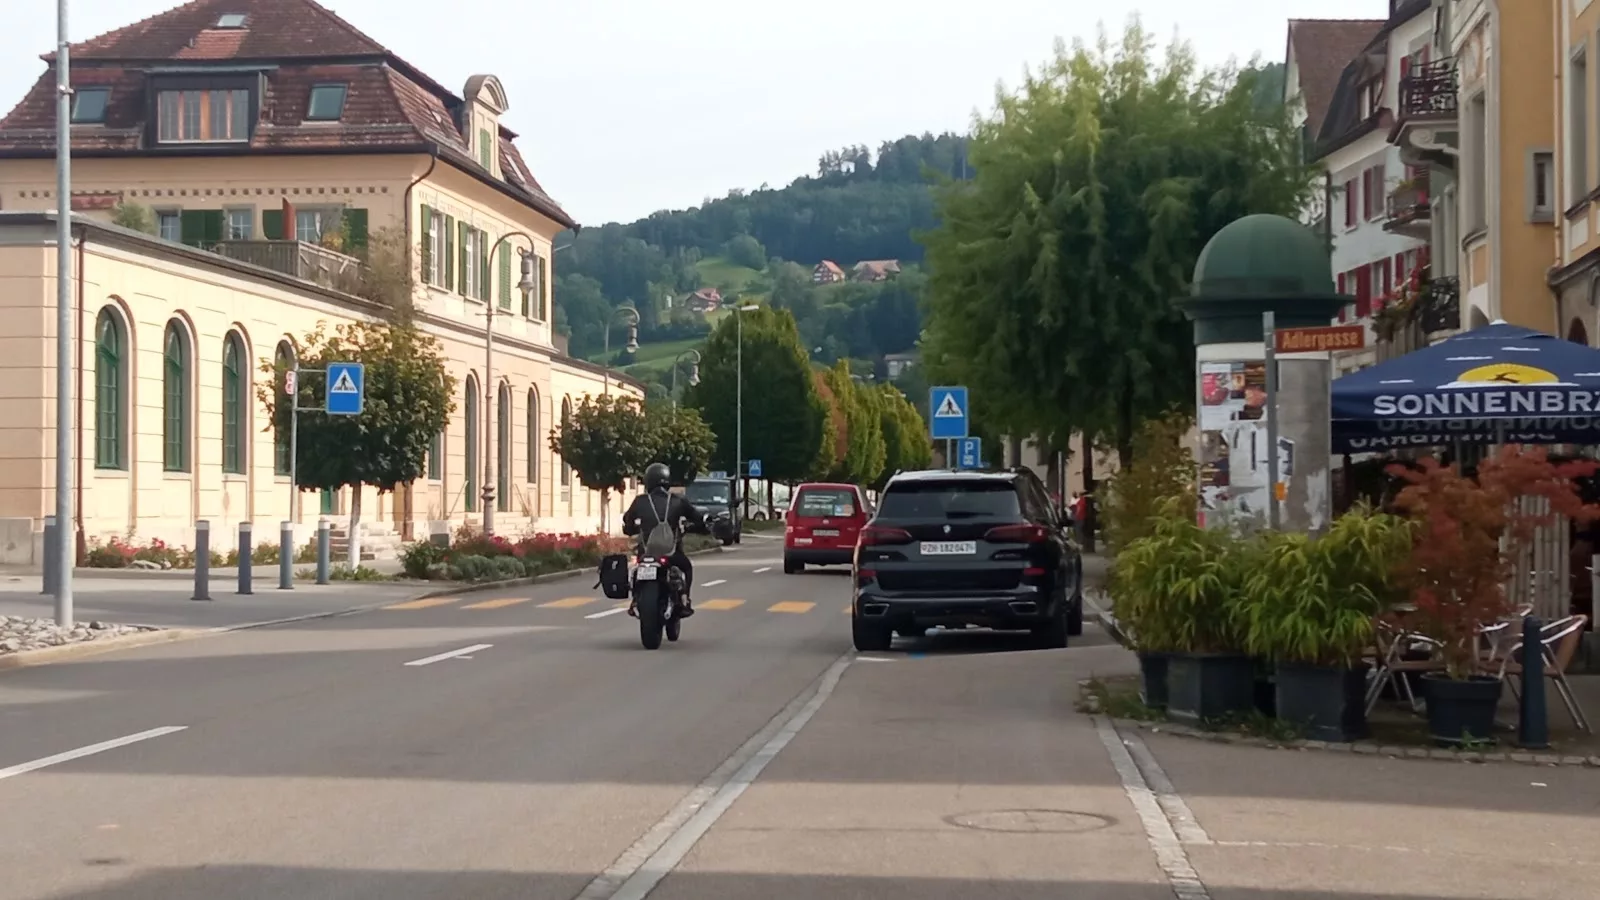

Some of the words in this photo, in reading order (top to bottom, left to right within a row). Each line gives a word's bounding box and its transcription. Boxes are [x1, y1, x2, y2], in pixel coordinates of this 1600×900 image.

[1282, 331, 1358, 350] Adlergasse
[1373, 391, 1600, 415] SONNENBR
[964, 441, 974, 455] P
